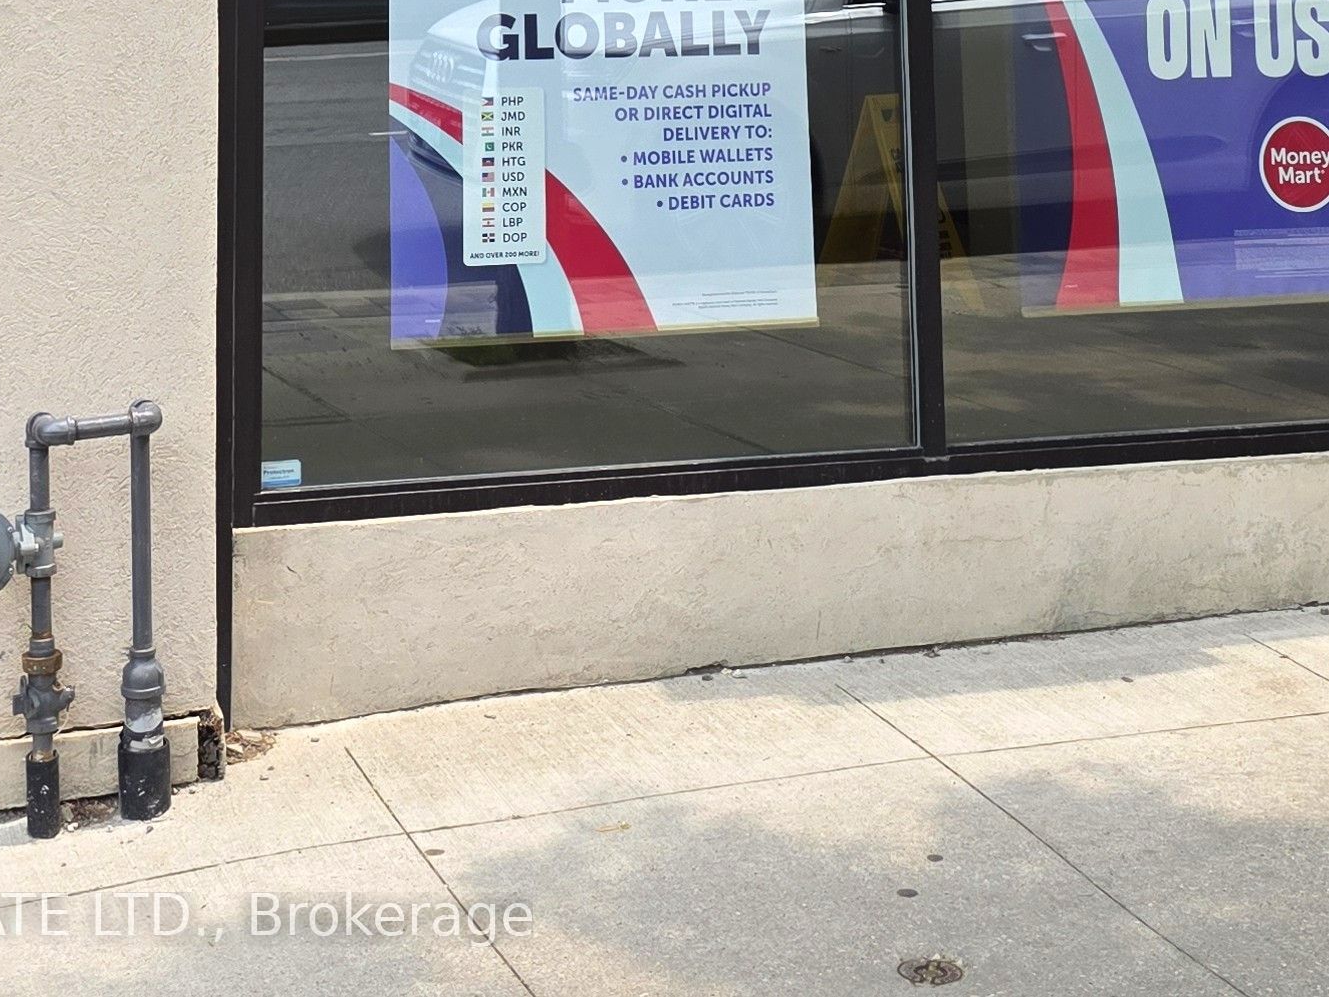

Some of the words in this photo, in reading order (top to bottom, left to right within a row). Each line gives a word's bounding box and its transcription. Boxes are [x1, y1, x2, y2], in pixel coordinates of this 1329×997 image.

[476, 9, 769, 61] GLOBALLY
[573, 85, 658, 102] SAME-DAY
[662, 84, 706, 100] CASH
[711, 82, 772, 98] PICKUP
[501, 96, 524, 107] PHP
[500, 111, 526, 122] JMD
[614, 107, 639, 121] OR
[643, 105, 704, 121] DIRECT
[708, 103, 772, 119] DIGITAL
[501, 126, 521, 137] INR
[663, 125, 741, 142] DELIVERY
[744, 125, 773, 140] TO:
[501, 141, 523, 152] PKR
[501, 156, 526, 167] HTG
[633, 150, 696, 166] MOBILE
[699, 147, 774, 163] WALLETS
[1270, 147, 1329, 168] Money
[502, 171, 525, 182] USD
[634, 173, 678, 189] BANK
[682, 169, 774, 187] ACCOUNTS
[1278, 166, 1322, 185] Mart
[502, 186, 527, 197] MXN
[502, 201, 527, 213] COP
[668, 194, 715, 211] DEBIT
[719, 192, 775, 208] CARDS
[502, 217, 523, 228] LBP
[502, 232, 527, 243] DOP
